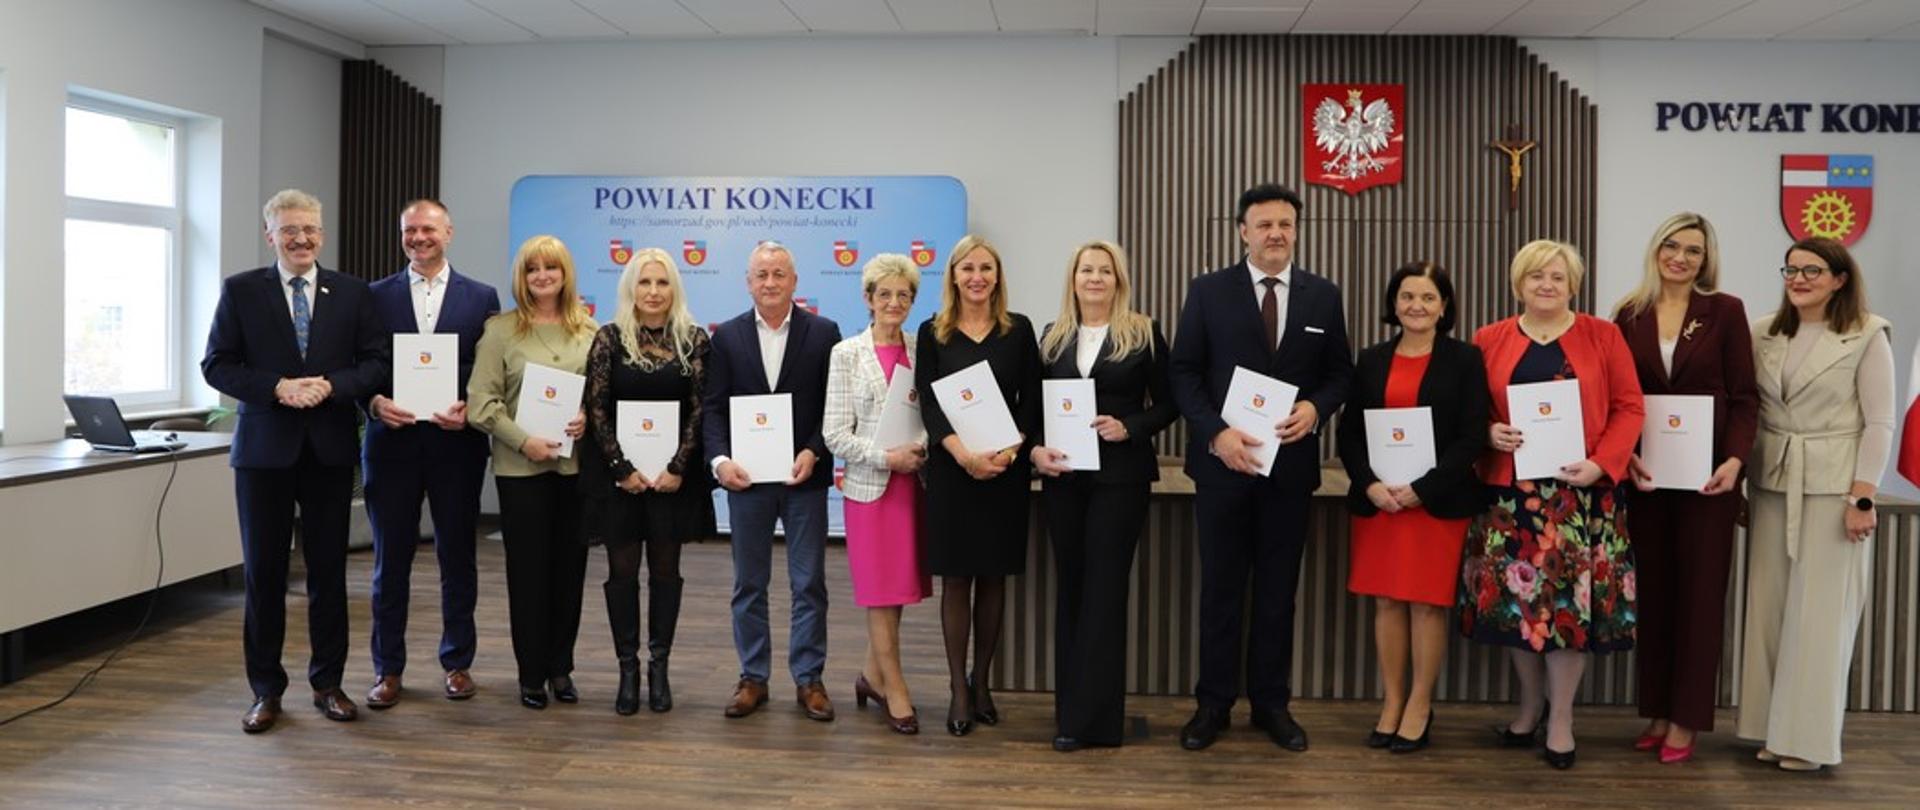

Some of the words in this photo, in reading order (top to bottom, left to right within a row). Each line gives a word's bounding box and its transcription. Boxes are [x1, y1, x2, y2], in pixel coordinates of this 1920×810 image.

[1656, 102, 1812, 132] POWIAT
[594, 186, 716, 210] POWIAT
[726, 187, 875, 210] KONECKI
